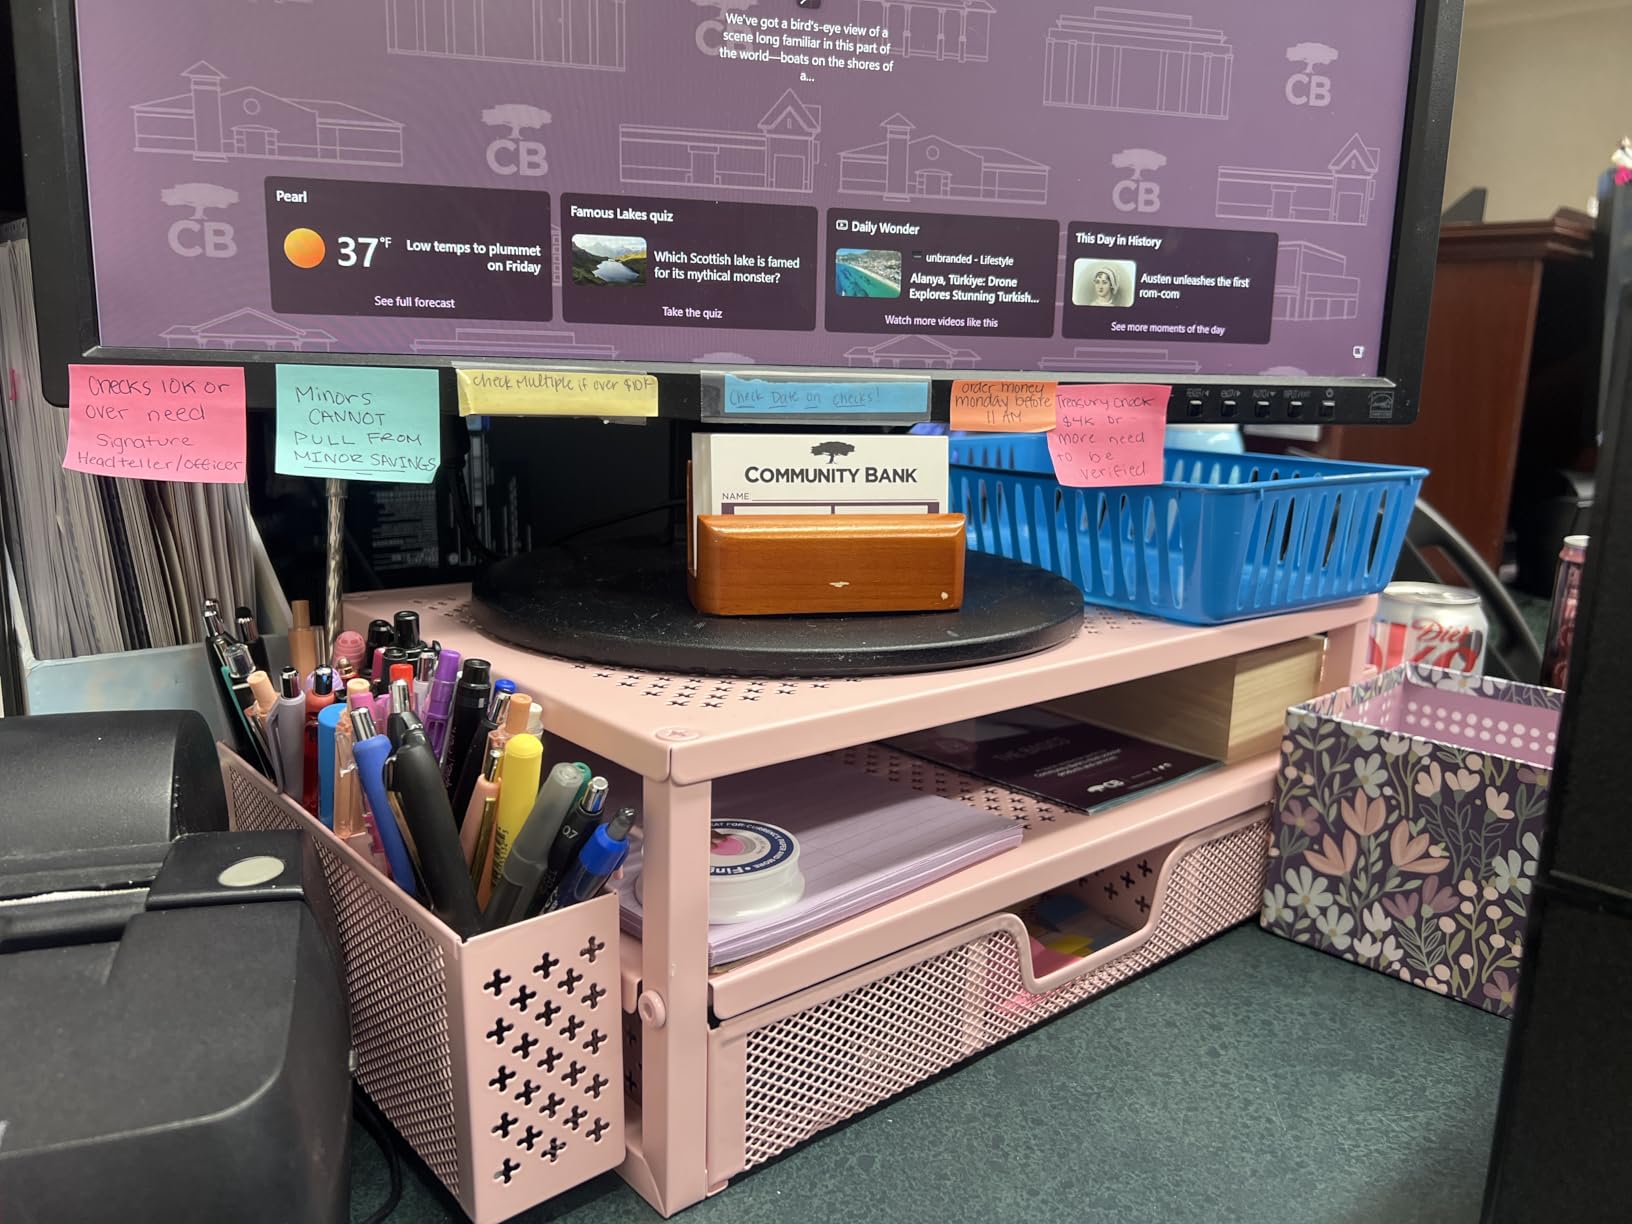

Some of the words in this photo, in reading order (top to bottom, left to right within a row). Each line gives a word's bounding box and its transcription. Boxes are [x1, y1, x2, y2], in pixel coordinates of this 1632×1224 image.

[725, 12, 758, 26] We've
[760, 18, 779, 30] got
[781, 20, 788, 28] a
[790, 18, 841, 36] bird's-eye
[843, 25, 867, 37] view
[869, 26, 880, 37] of
[882, 29, 889, 38] a
[723, 31, 753, 43] scene
[756, 32, 779, 47] long
[782, 35, 821, 49] familiar
[823, 37, 833, 50] in
[835, 38, 854, 52] this
[856, 43, 877, 55] part
[879, 43, 891, 55] of
[719, 47, 737, 59] the
[811, 57, 826, 67] on
[828, 55, 845, 68] the
[847, 56, 880, 71] shores
[882, 61, 894, 72] of
[1285, 73, 1332, 107] CB
[485, 139, 548, 177] CB
[276, 190, 307, 203] Pearl
[1112, 180, 1161, 213] CB
[570, 205, 614, 220] Famous
[616, 208, 647, 221] Lakes
[650, 210, 674, 224] quiz
[851, 220, 877, 236] Daily
[879, 222, 920, 236] Wonder
[167, 219, 238, 259] CB
[1075, 232, 1094, 244] This
[1096, 234, 1116, 248] Day
[1117, 235, 1126, 246] in
[1128, 235, 1162, 250] History
[406, 239, 431, 252] Low
[433, 241, 471, 256] temps
[472, 242, 486, 254] to
[488, 243, 541, 259] plummet
[487, 261, 503, 272] on
[506, 260, 541, 275] Friday
[653, 251, 687, 264] Which
[690, 252, 732, 266] Scottish
[733, 254, 755, 267] lake
[757, 256, 766, 267] is
[767, 256, 800, 269] famed
[925, 253, 973, 265] unbranded
[979, 255, 1014, 267] Lifestyle
[654, 266, 671, 279] for
[672, 268, 684, 280] its
[687, 269, 731, 283] mythical
[733, 271, 781, 284] monster?
[910, 273, 946, 287] Alanya,
[948, 274, 986, 288] Türkiye:
[987, 275, 1018, 288] Drone
[1140, 273, 1171, 285] Austen
[1173, 274, 1216, 287] unleashes
[1216, 276, 1231, 287] the
[1232, 276, 1250, 288] first
[374, 295, 394, 307] See
[396, 296, 412, 308] full
[414, 297, 456, 309] forecast
[909, 288, 951, 302] Explores
[952, 290, 995, 304] Stunning
[997, 291, 1040, 304] Turkish...
[1139, 289, 1180, 300] rom-com
[662, 306, 683, 317] Take
[685, 307, 701, 318] the
[702, 308, 723, 320] quiz
[884, 314, 912, 326] Watch
[914, 317, 936, 326] more
[937, 316, 965, 327] videos
[966, 317, 981, 328] like
[983, 317, 998, 328] this
[1111, 321, 1126, 332] See
[1127, 323, 1148, 333] more
[1149, 323, 1186, 334] moments
[1187, 324, 1196, 334] of
[1196, 325, 1209, 334] the
[1210, 325, 1226, 336] day
[161, 378, 196, 395] 10K
[593, 379, 618, 391] over
[295, 386, 373, 406] Minors
[147, 403, 205, 423] need
[309, 408, 386, 426] CANNOT
[1002, 411, 1022, 424] AM
[294, 431, 356, 446] PULL
[367, 432, 422, 446] FROM
[1058, 433, 1097, 444] more
[1109, 432, 1145, 444] need
[293, 450, 364, 464] MINOR
[370, 453, 437, 472] SAVINGS
[1057, 453, 1073, 463] to
[1088, 451, 1115, 464] be
[744, 466, 860, 484] COMMUNITY
[865, 466, 918, 484] BANK
[1080, 463, 1146, 481] verified
[722, 492, 750, 500] NAME
[1412, 617, 1470, 644] Diet
